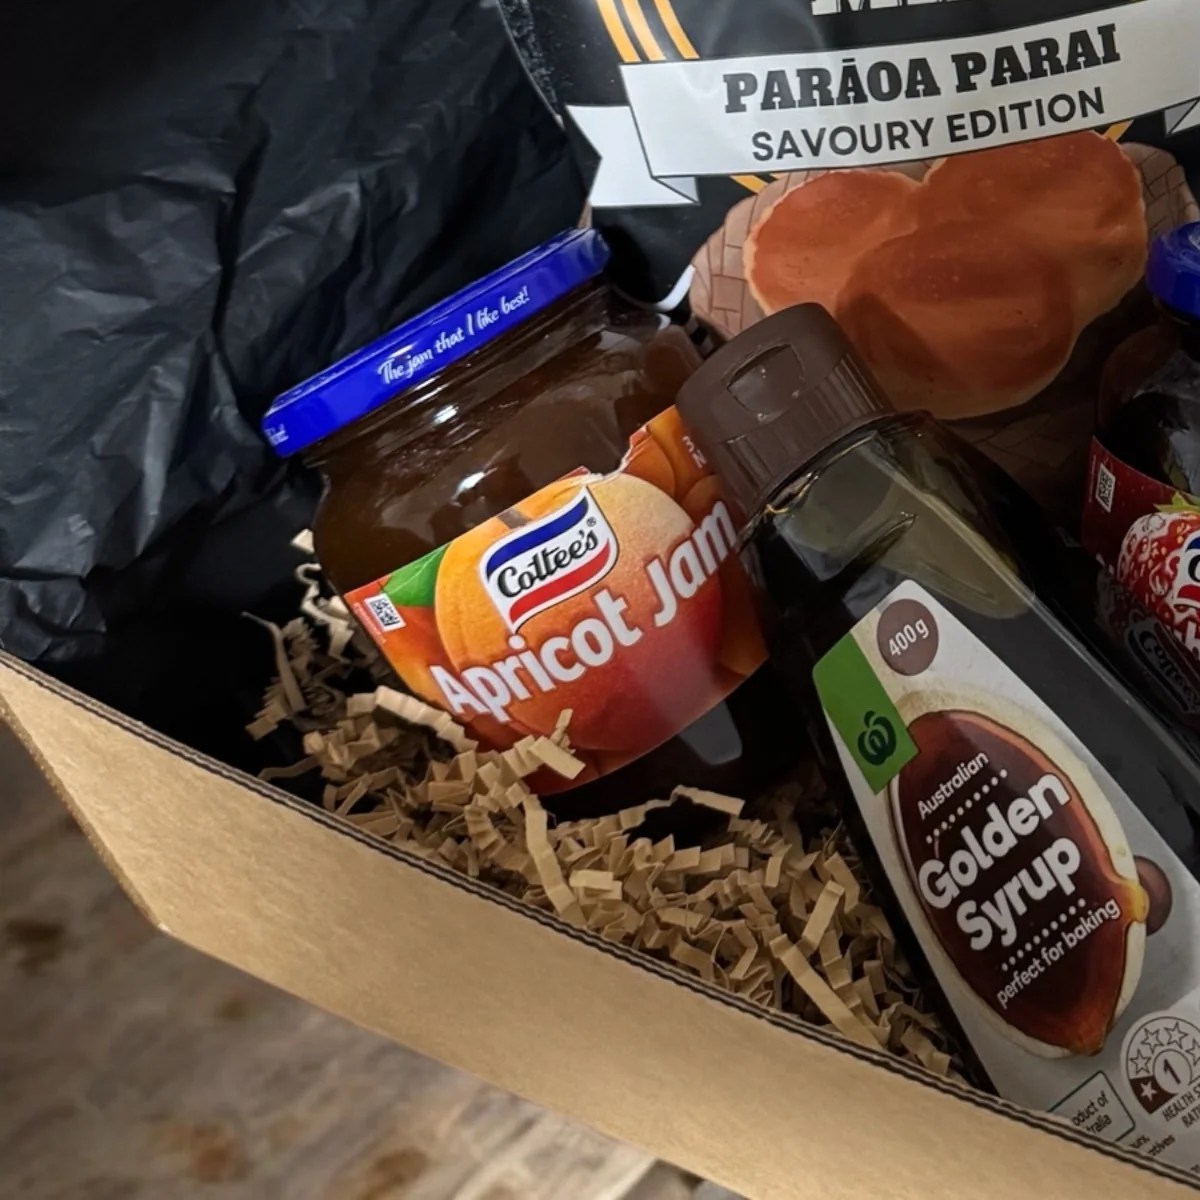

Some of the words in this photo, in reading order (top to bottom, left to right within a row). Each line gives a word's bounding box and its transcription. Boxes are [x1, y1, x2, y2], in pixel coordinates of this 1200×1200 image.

[723, 57, 941, 115] PARĀOA
[951, 23, 1122, 89] PARAI
[751, 116, 935, 162] SAVOURY
[949, 86, 1105, 143] EDITION
[377, 358, 404, 385] The
[403, 349, 434, 379] jam
[434, 327, 465, 353] that
[466, 313, 475, 336] I
[476, 306, 500, 330] like
[500, 285, 530, 315] best!
[496, 531, 600, 600] Cottee's
[429, 590, 644, 723] Apricot
[653, 500, 739, 625] Jam
[916, 750, 990, 820] Australian
[917, 771, 1071, 910] Golden
[955, 837, 1082, 951] Syrup
[997, 963, 1044, 1010] perfect
[1041, 941, 1066, 967] for
[1062, 897, 1122, 953] baking
[1097, 1089, 1110, 1108] of
[1161, 1093, 1194, 1122] HEALTH
[1162, 1058, 1182, 1085] 1
